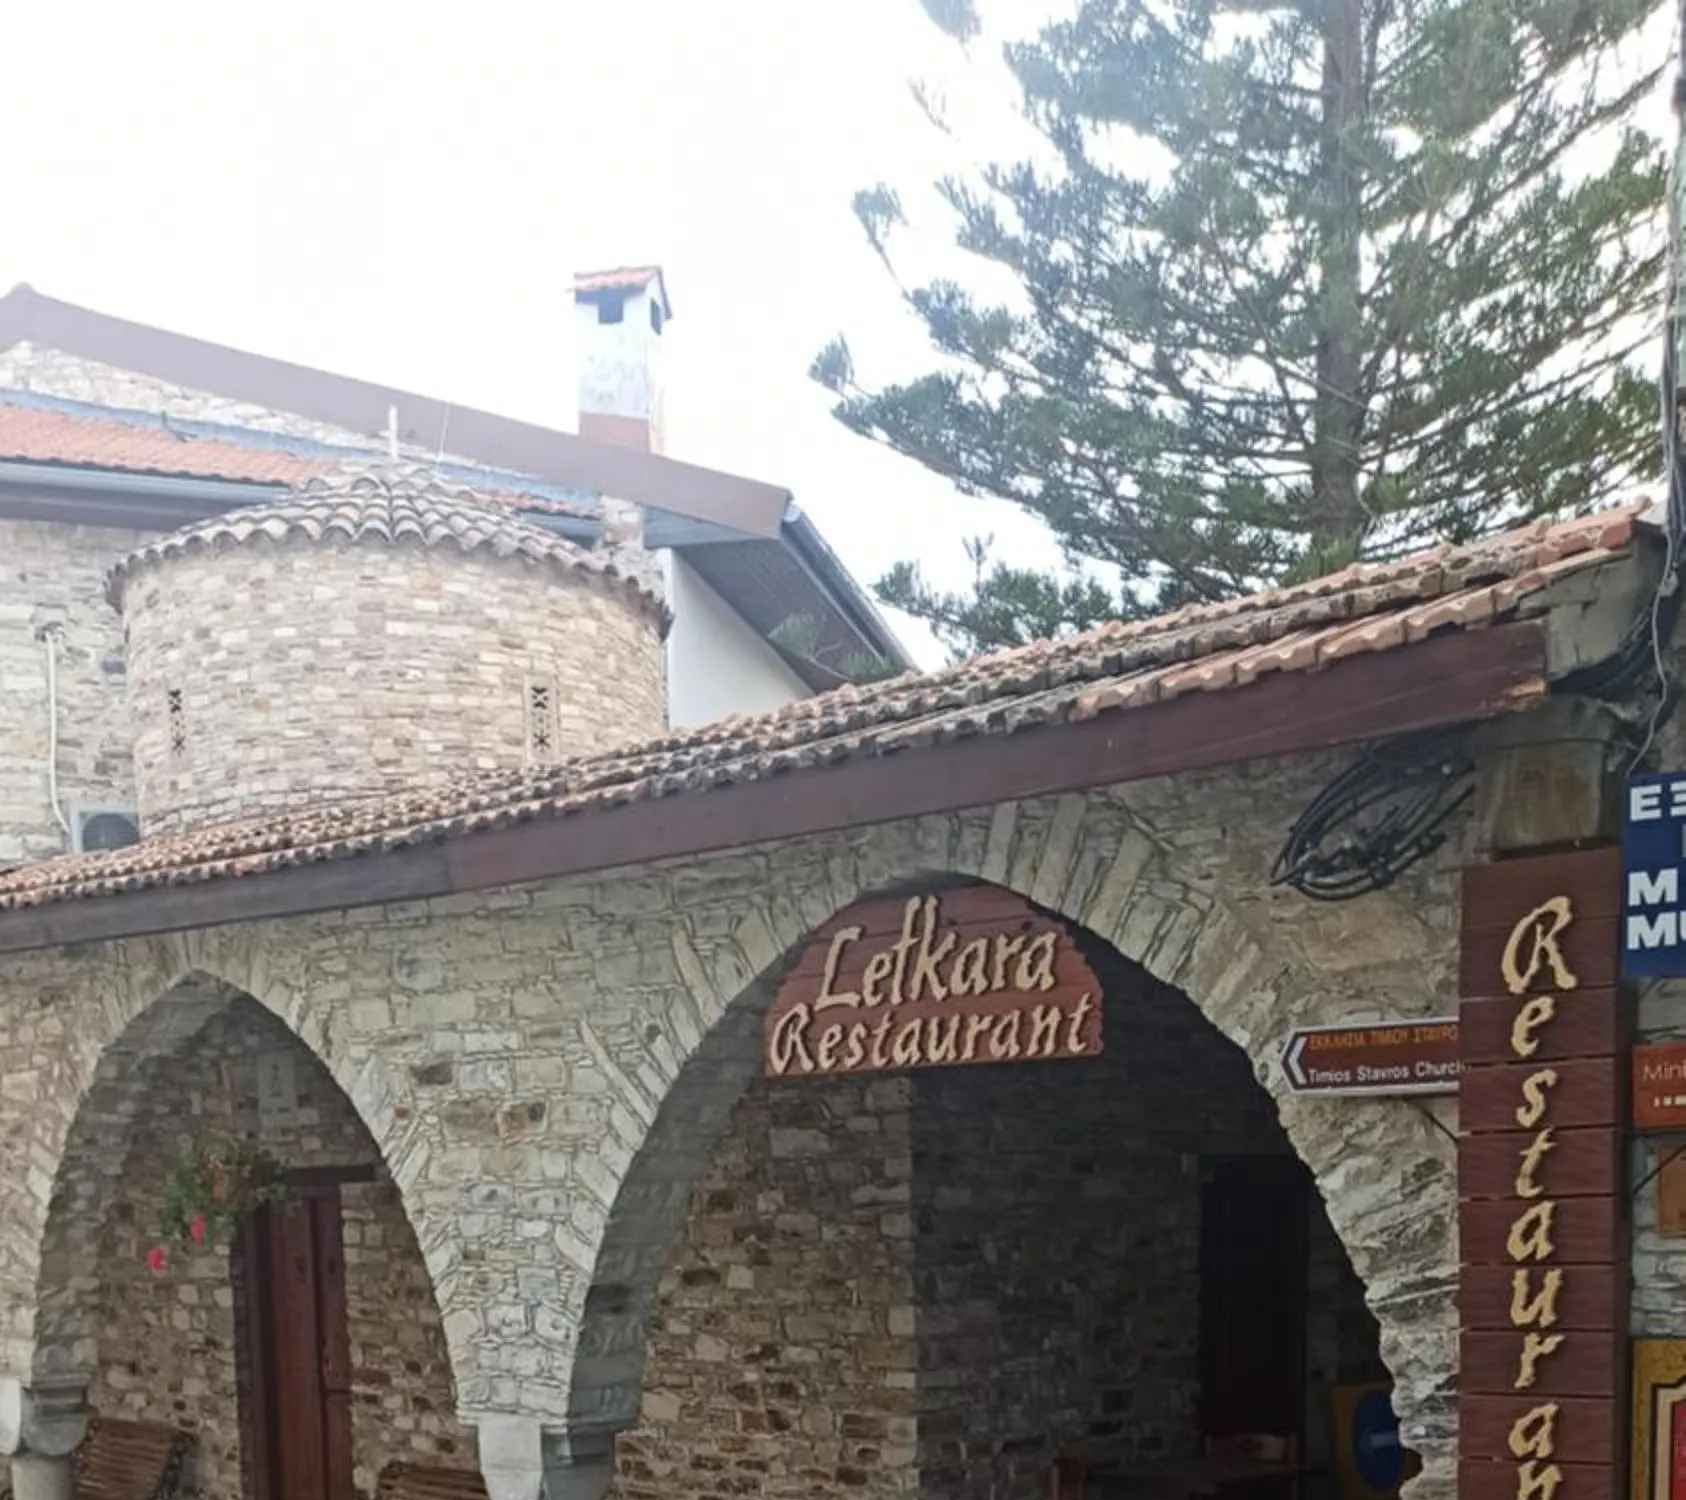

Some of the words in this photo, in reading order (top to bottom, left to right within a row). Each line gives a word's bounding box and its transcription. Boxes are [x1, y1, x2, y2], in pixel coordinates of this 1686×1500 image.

[815, 895, 1058, 1012] Lefkara
[770, 992, 1093, 1074] Restaurant
[1413, 1025, 1458, 1044] ΣΤΑΥΡΟ
[1308, 1068, 1351, 1084] Timios
[1356, 1064, 1410, 1082] Stavros
